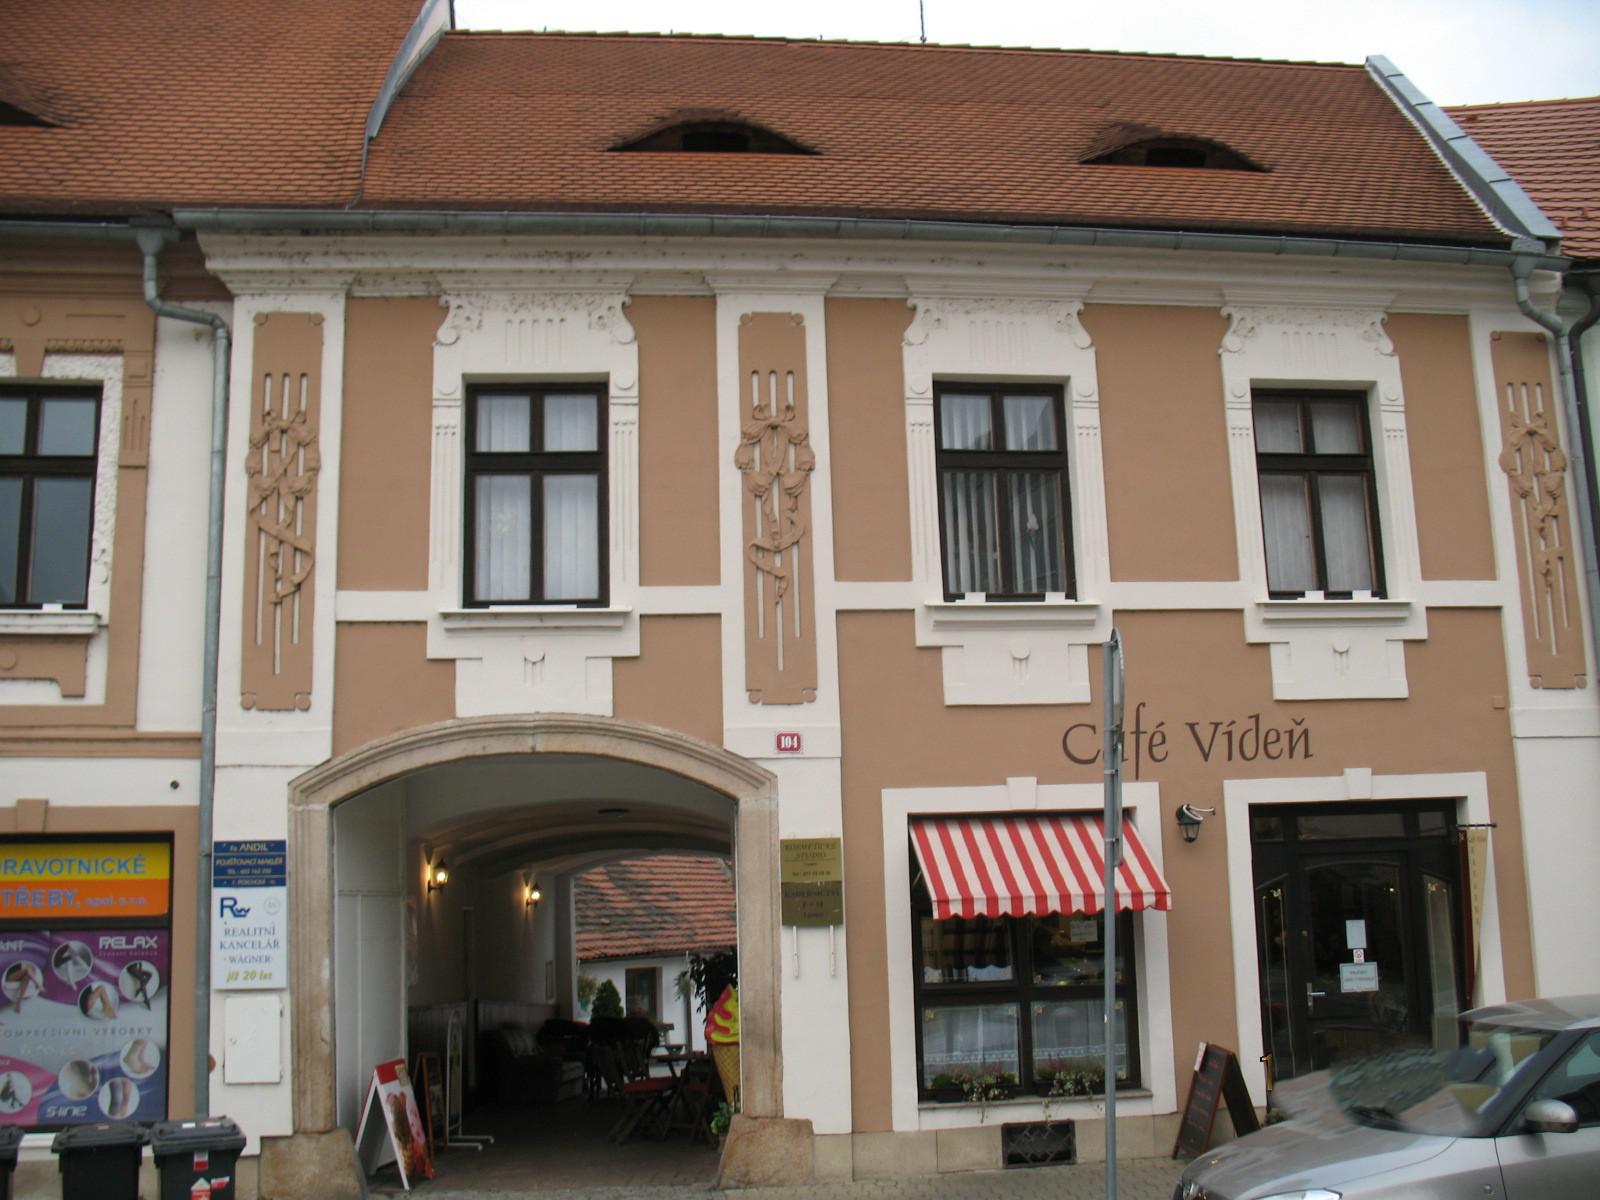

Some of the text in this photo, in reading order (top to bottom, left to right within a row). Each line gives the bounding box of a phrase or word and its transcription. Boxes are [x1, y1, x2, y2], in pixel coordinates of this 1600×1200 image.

[1062, 702, 1313, 780] Cfé Vídeň
[0, 854, 147, 875] RAVOTNICKÉ
[99, 936, 157, 949] RELAX
[243, 970, 256, 981] 20
